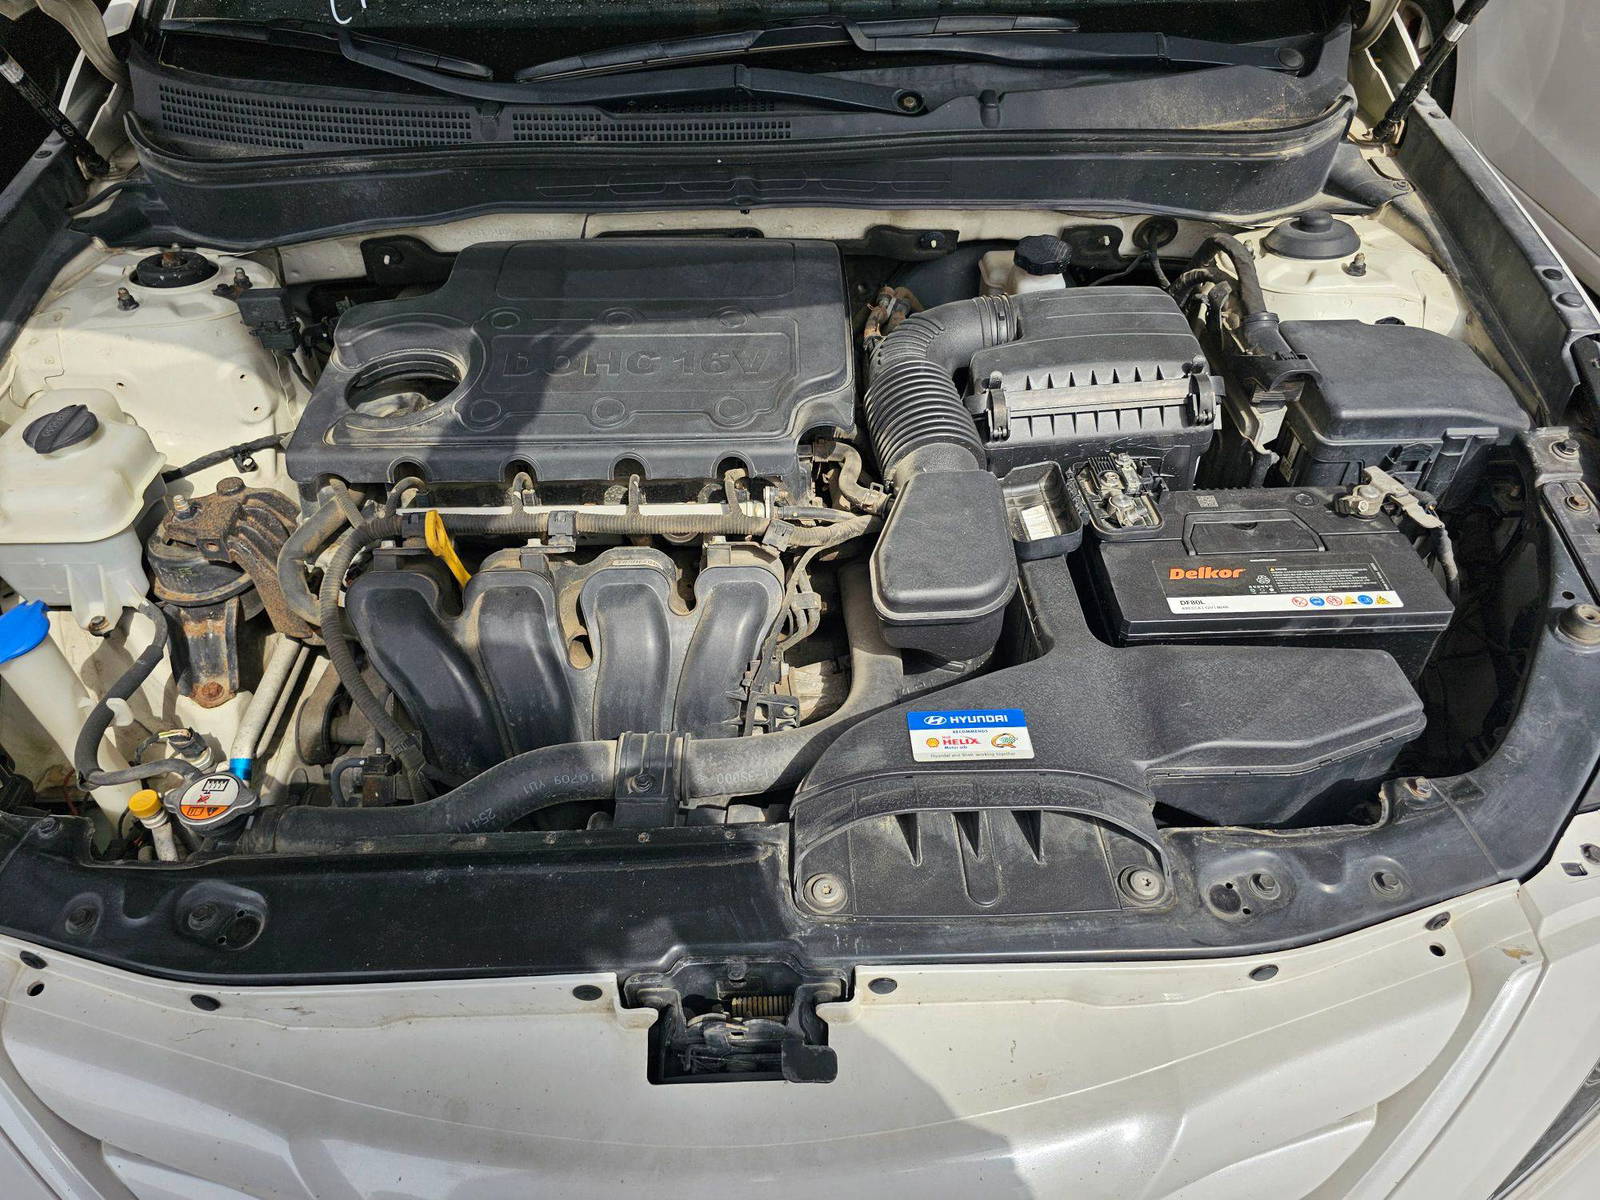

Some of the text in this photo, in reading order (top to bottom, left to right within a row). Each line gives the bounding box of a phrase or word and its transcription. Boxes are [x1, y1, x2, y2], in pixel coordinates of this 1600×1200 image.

[502, 349, 773, 377] DOHC 16V
[1169, 566, 1246, 580] Delkor
[949, 714, 1008, 724] HYUNDAI
